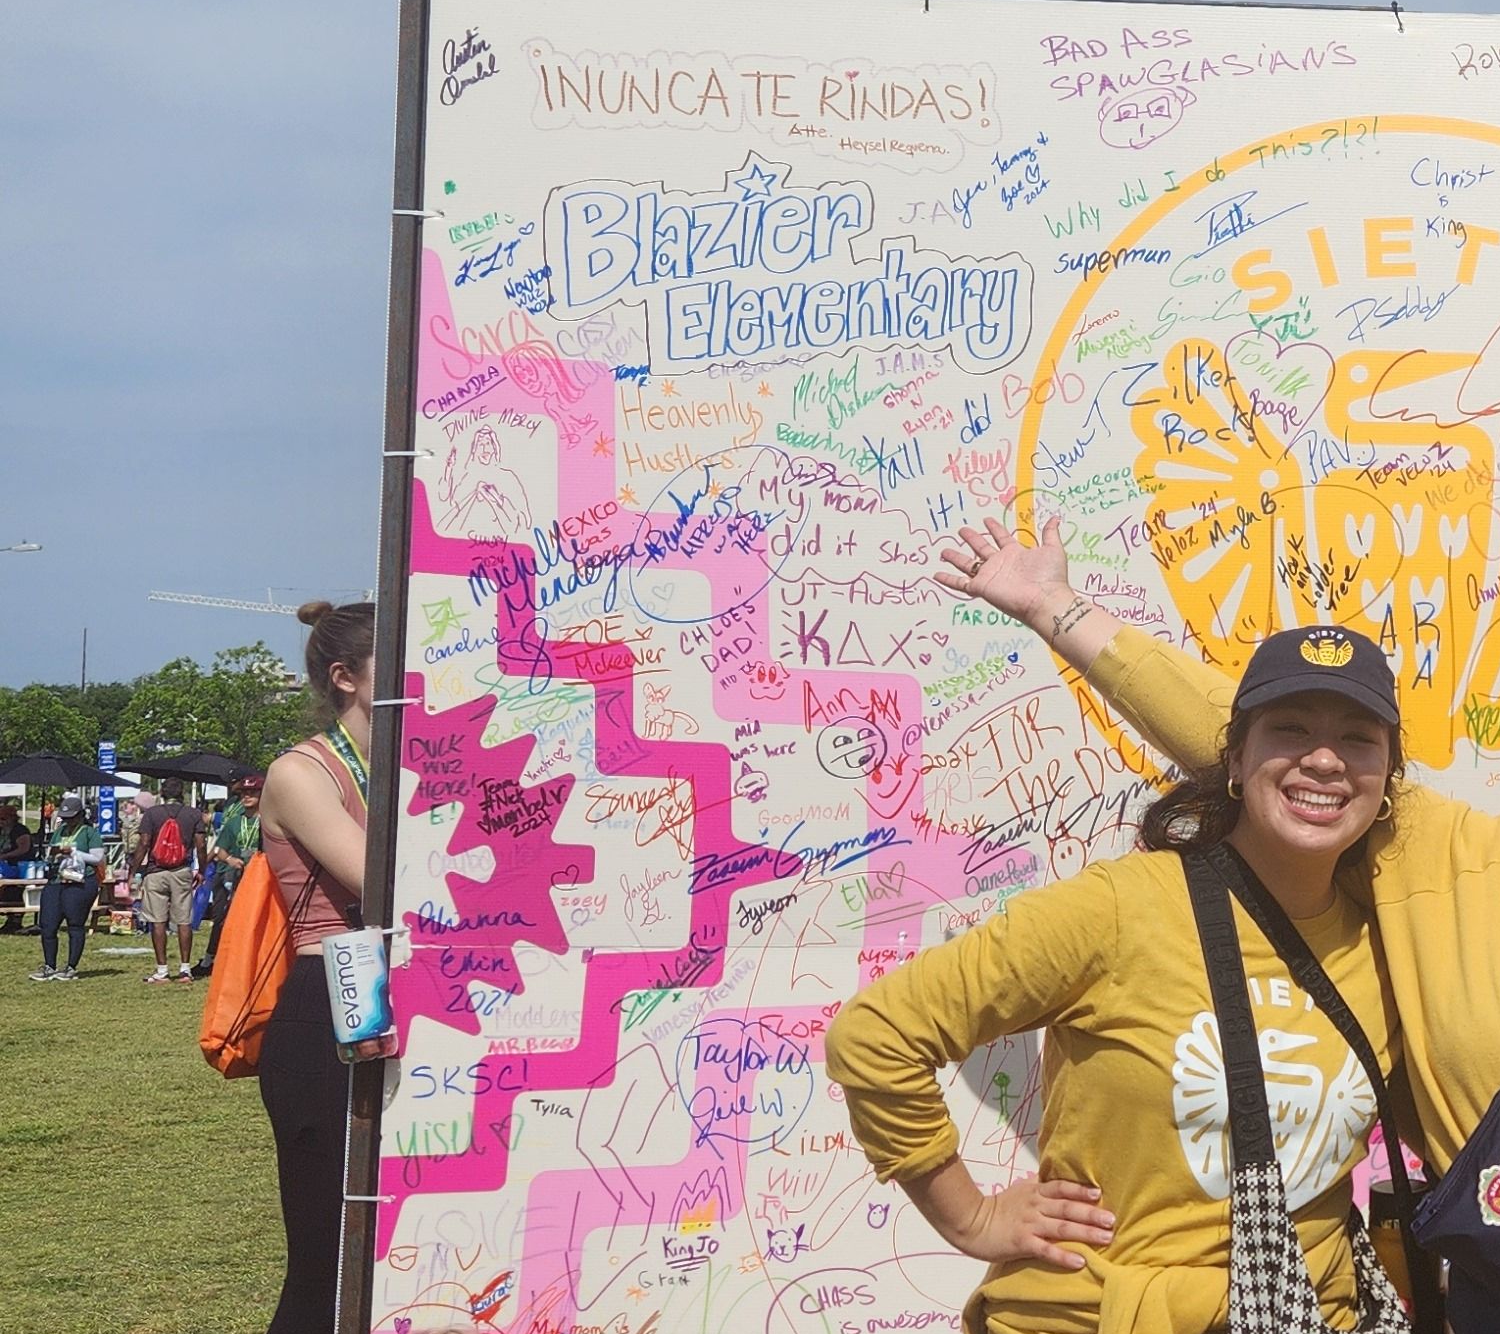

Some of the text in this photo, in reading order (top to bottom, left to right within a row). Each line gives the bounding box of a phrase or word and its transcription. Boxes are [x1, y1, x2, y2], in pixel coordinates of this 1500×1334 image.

[1040, 27, 1194, 67] BAD ASS
[740, 69, 800, 118] TE
[1410, 158, 1496, 187] Christ
[1044, 201, 1100, 239] Why
[1118, 178, 1149, 208] did
[1164, 170, 1180, 193] I
[562, 191, 861, 307] Blazier
[1425, 217, 1468, 249] King
[666, 249, 1018, 361] Elementary
[421, 364, 500, 420] CHANDRA
[1001, 358, 1086, 419] Bob
[442, 404, 490, 443] DIVINE
[619, 381, 763, 449] Heavenly
[550, 500, 619, 544] MEXICO
[759, 477, 879, 524] My mom
[769, 523, 822, 558] did
[835, 529, 857, 557] it
[1084, 572, 1148, 599] Madison
[1073, 729, 1149, 800] DOG
[333, 941, 362, 1031] evamor
[410, 1057, 533, 1099] SKSC!
